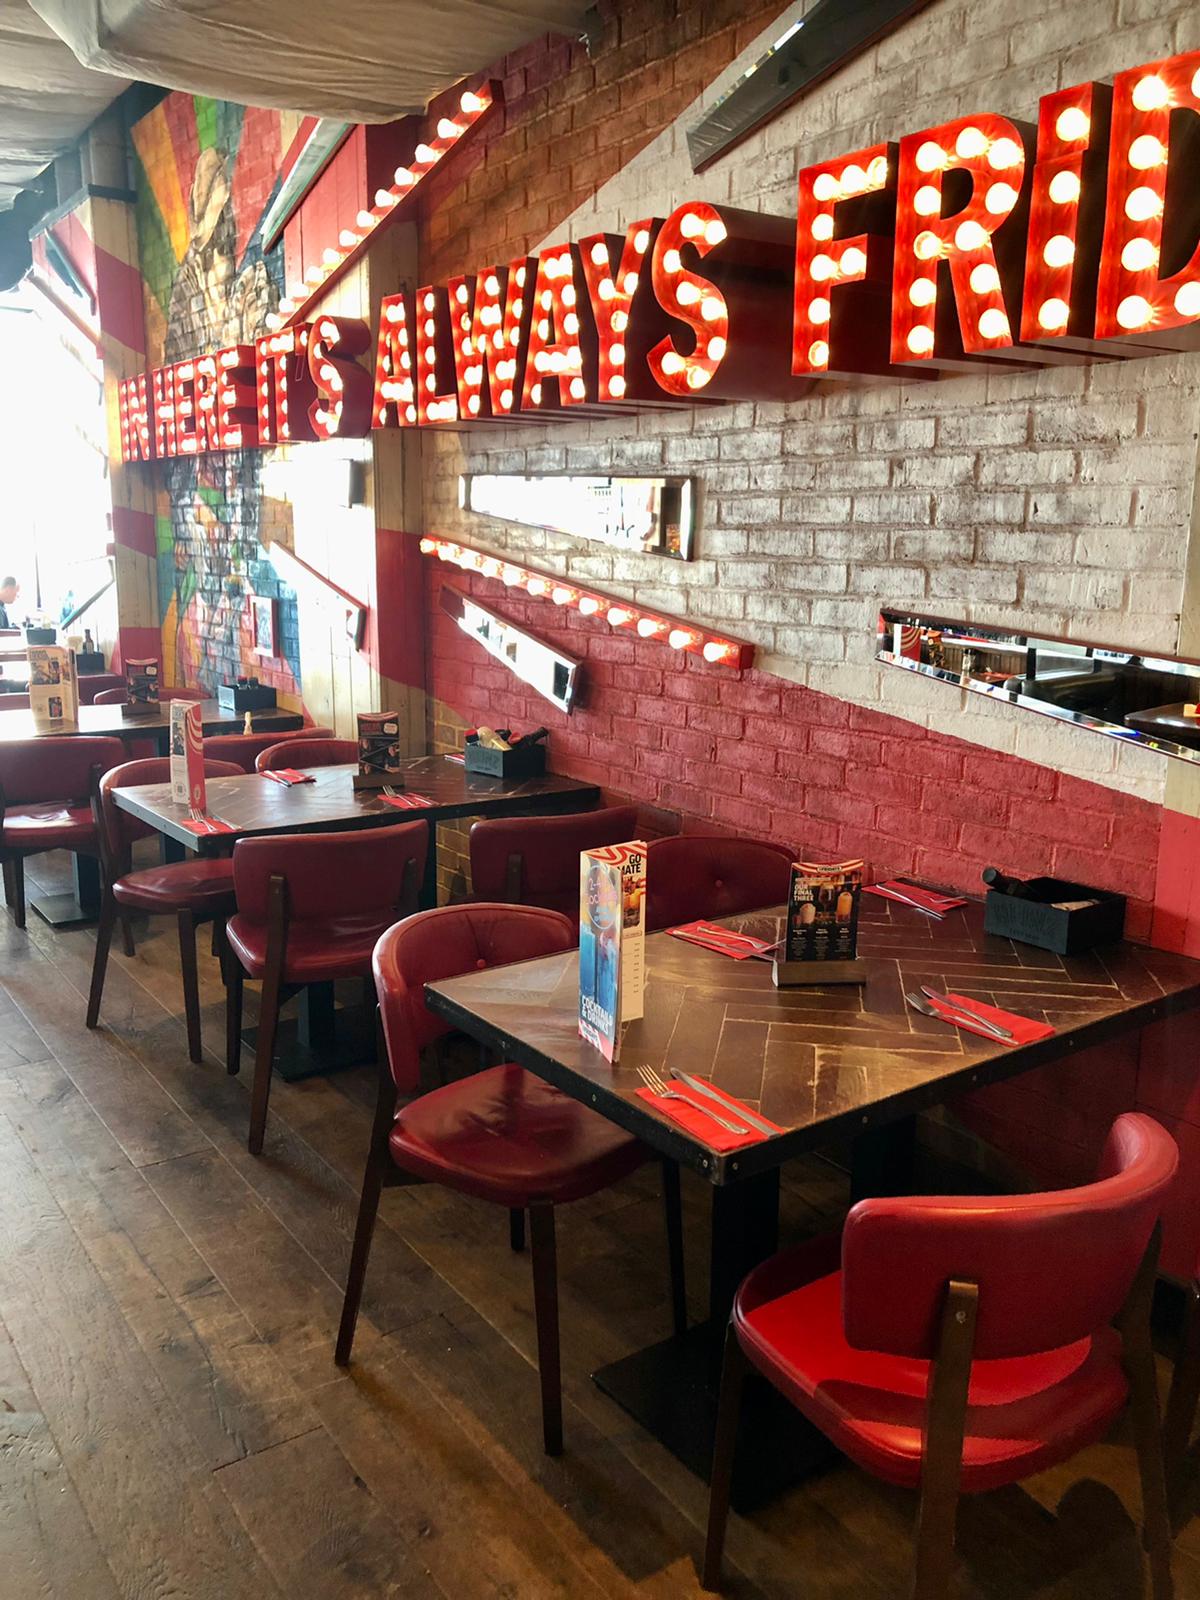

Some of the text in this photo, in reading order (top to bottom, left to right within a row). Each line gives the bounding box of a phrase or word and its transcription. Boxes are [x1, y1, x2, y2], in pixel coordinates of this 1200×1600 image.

[118, 372, 150, 464] IN
[152, 346, 244, 458] HERE
[255, 315, 346, 446] IT'S
[371, 201, 728, 430] ALWAYS
